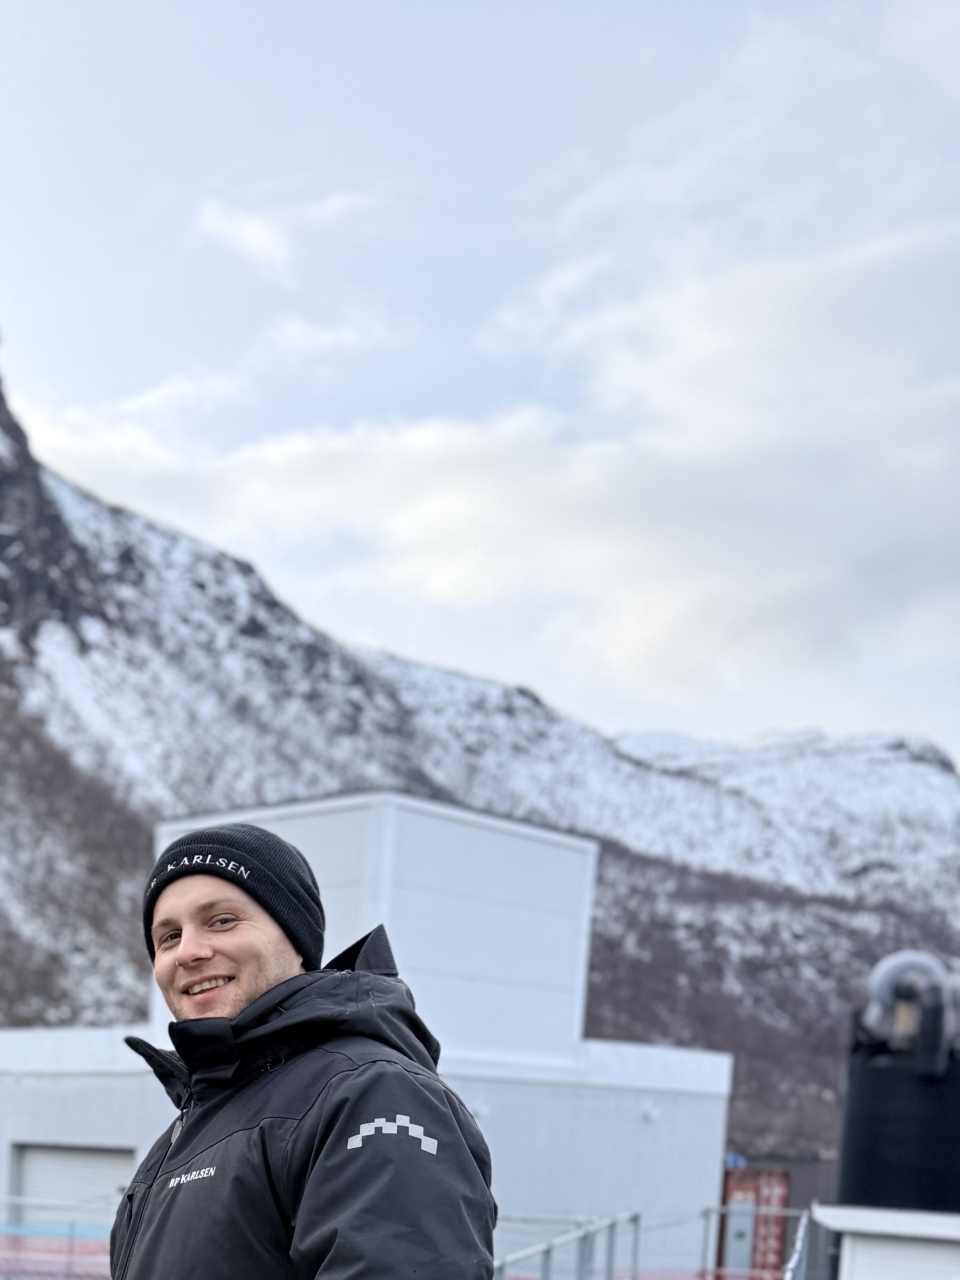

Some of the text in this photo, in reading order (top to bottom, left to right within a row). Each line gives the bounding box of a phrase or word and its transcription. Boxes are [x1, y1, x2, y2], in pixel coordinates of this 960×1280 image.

[167, 854, 251, 880] KARLSEN
[168, 1166, 216, 1188] BP KARLSEN
